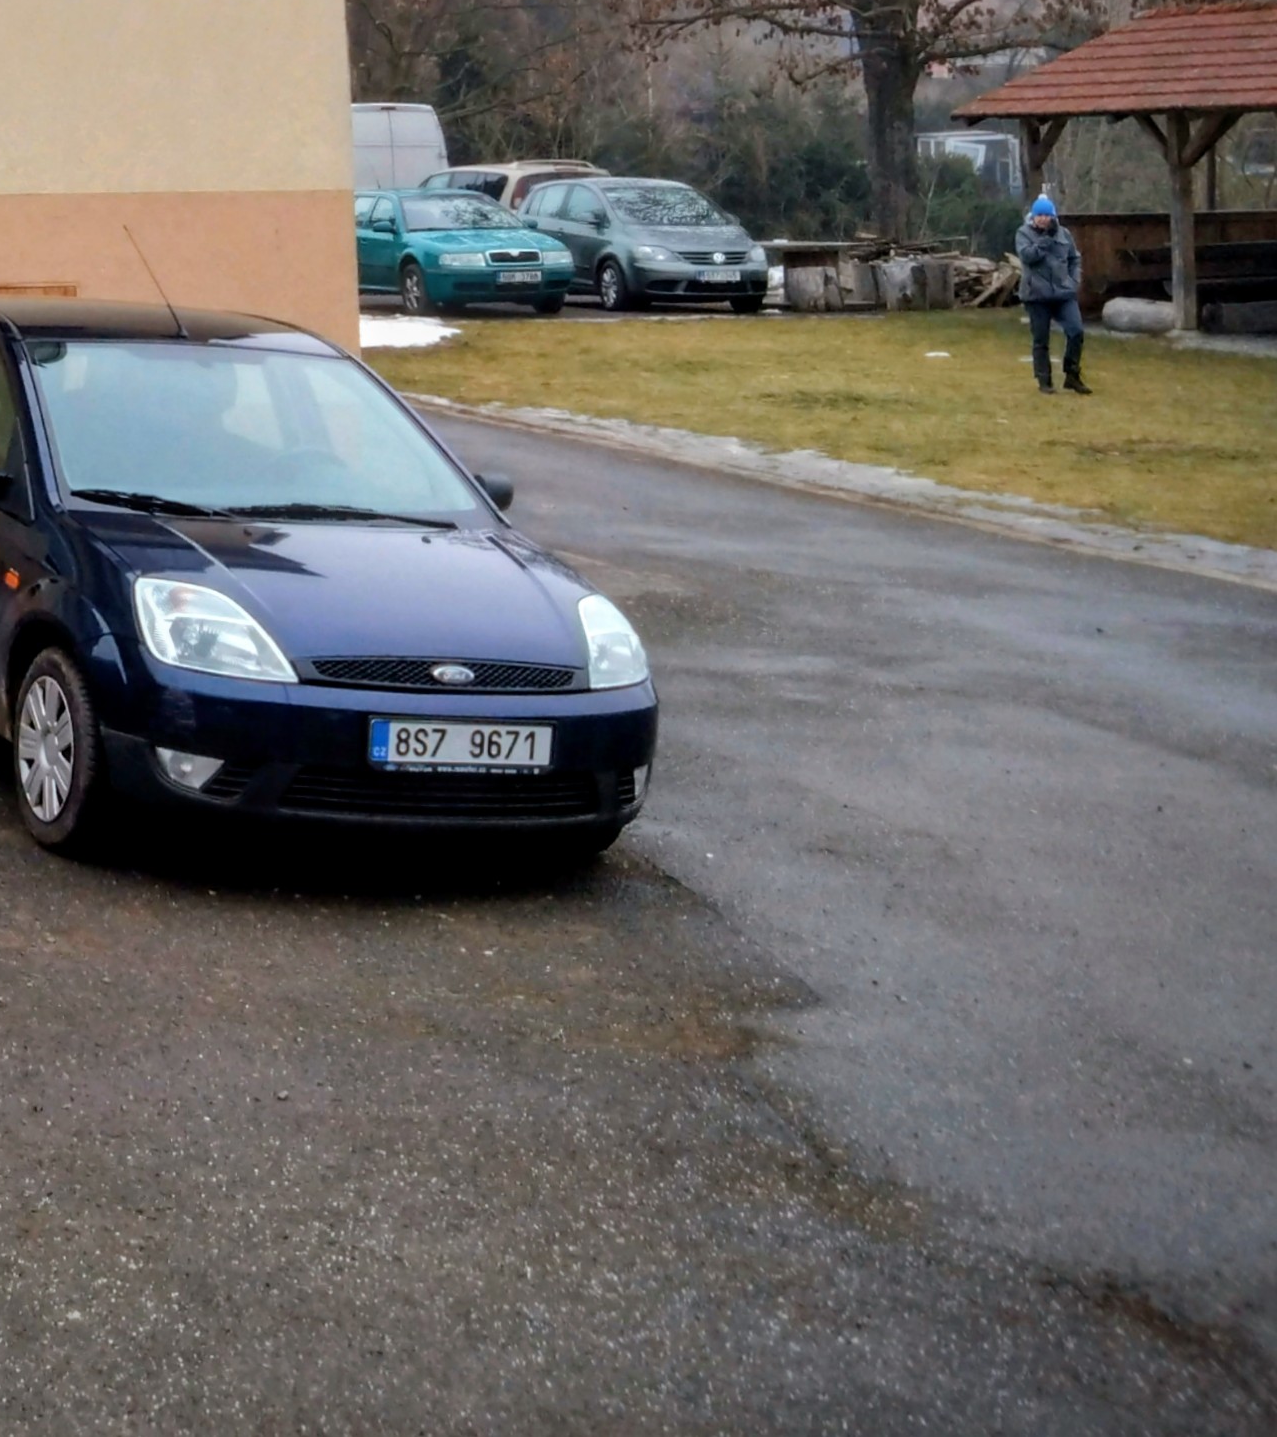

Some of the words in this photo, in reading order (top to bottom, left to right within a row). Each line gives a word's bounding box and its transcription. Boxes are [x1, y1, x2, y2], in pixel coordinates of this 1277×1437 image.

[373, 746, 387, 757] CZ
[396, 727, 448, 757] 8S7
[469, 730, 536, 761] 9671
